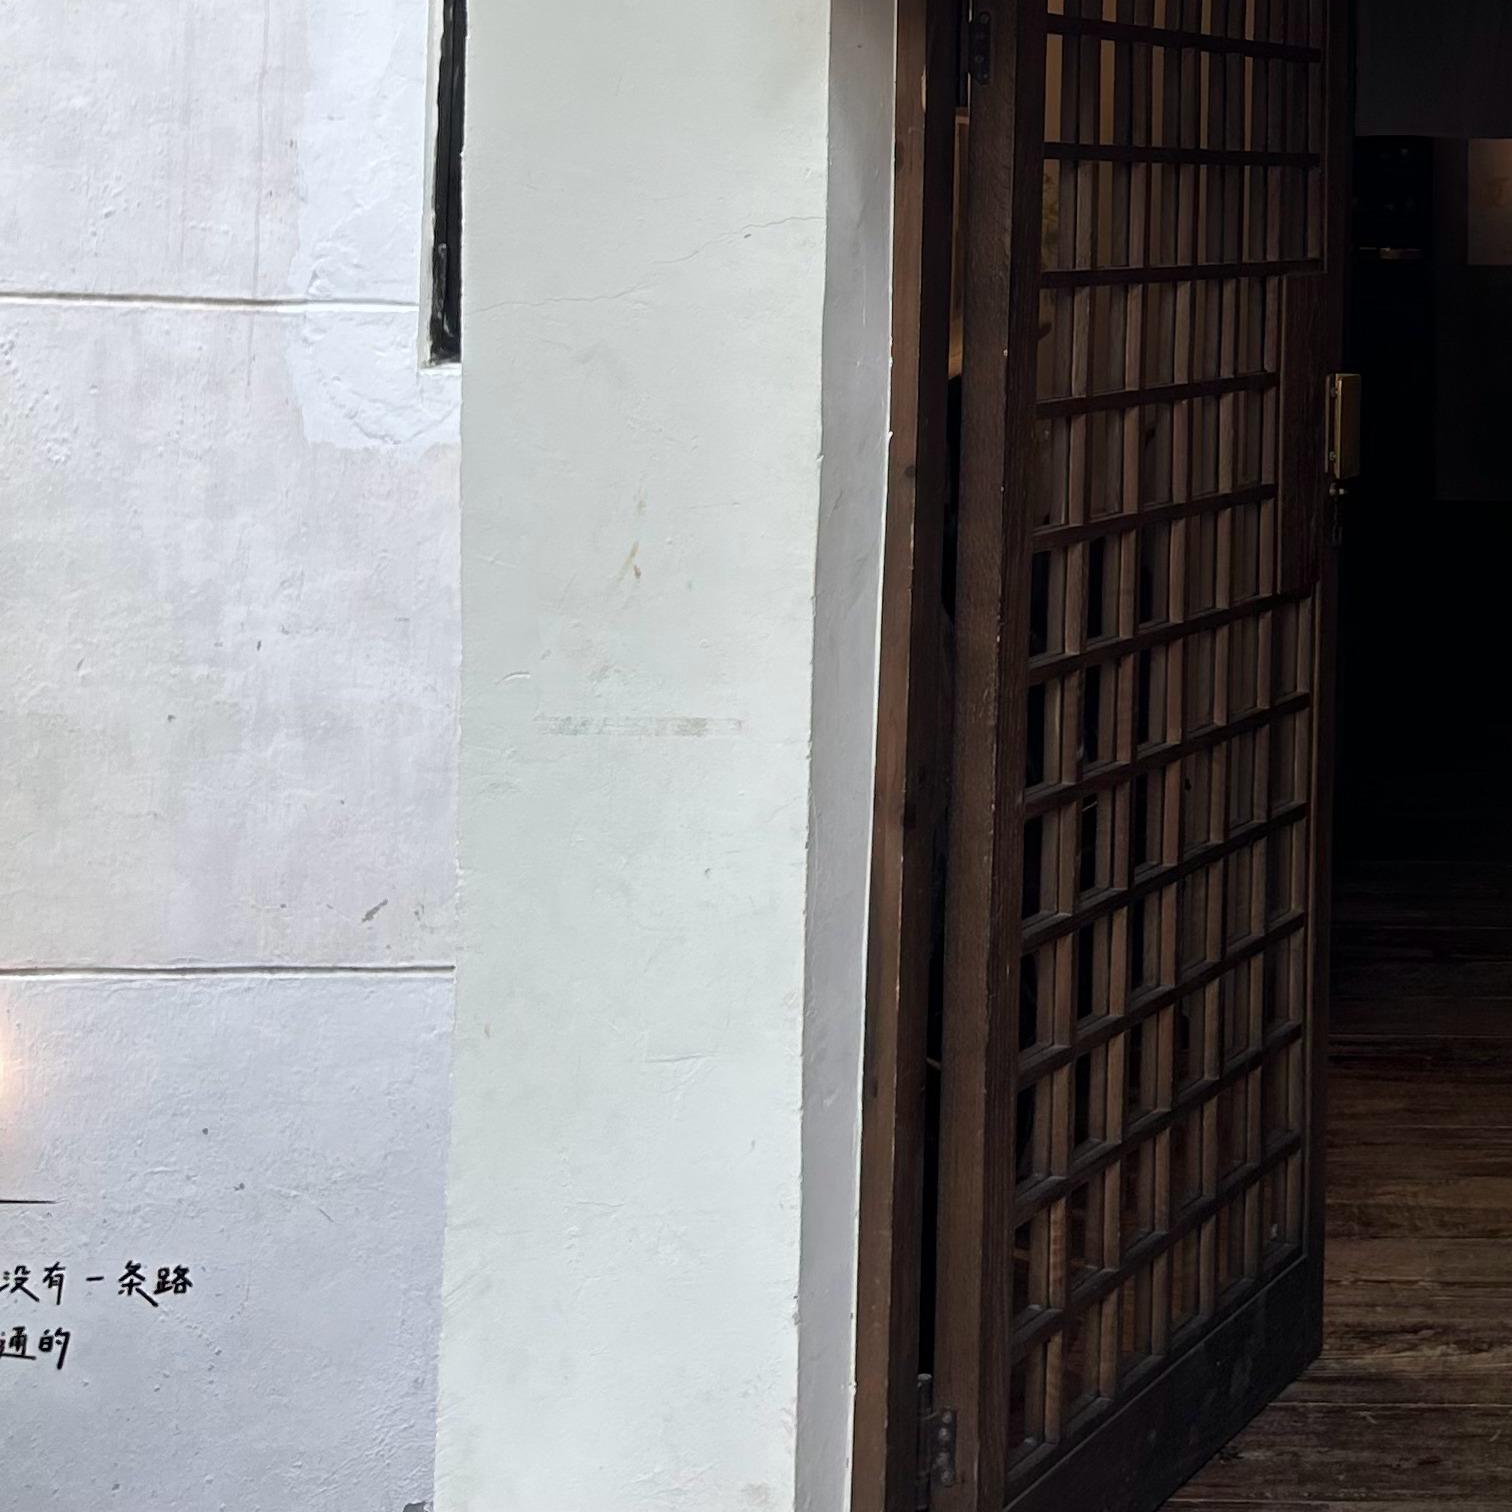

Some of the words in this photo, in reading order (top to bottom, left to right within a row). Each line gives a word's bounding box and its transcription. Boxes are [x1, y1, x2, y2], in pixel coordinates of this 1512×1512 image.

[0, 1260, 193, 1307] 没有一条路
